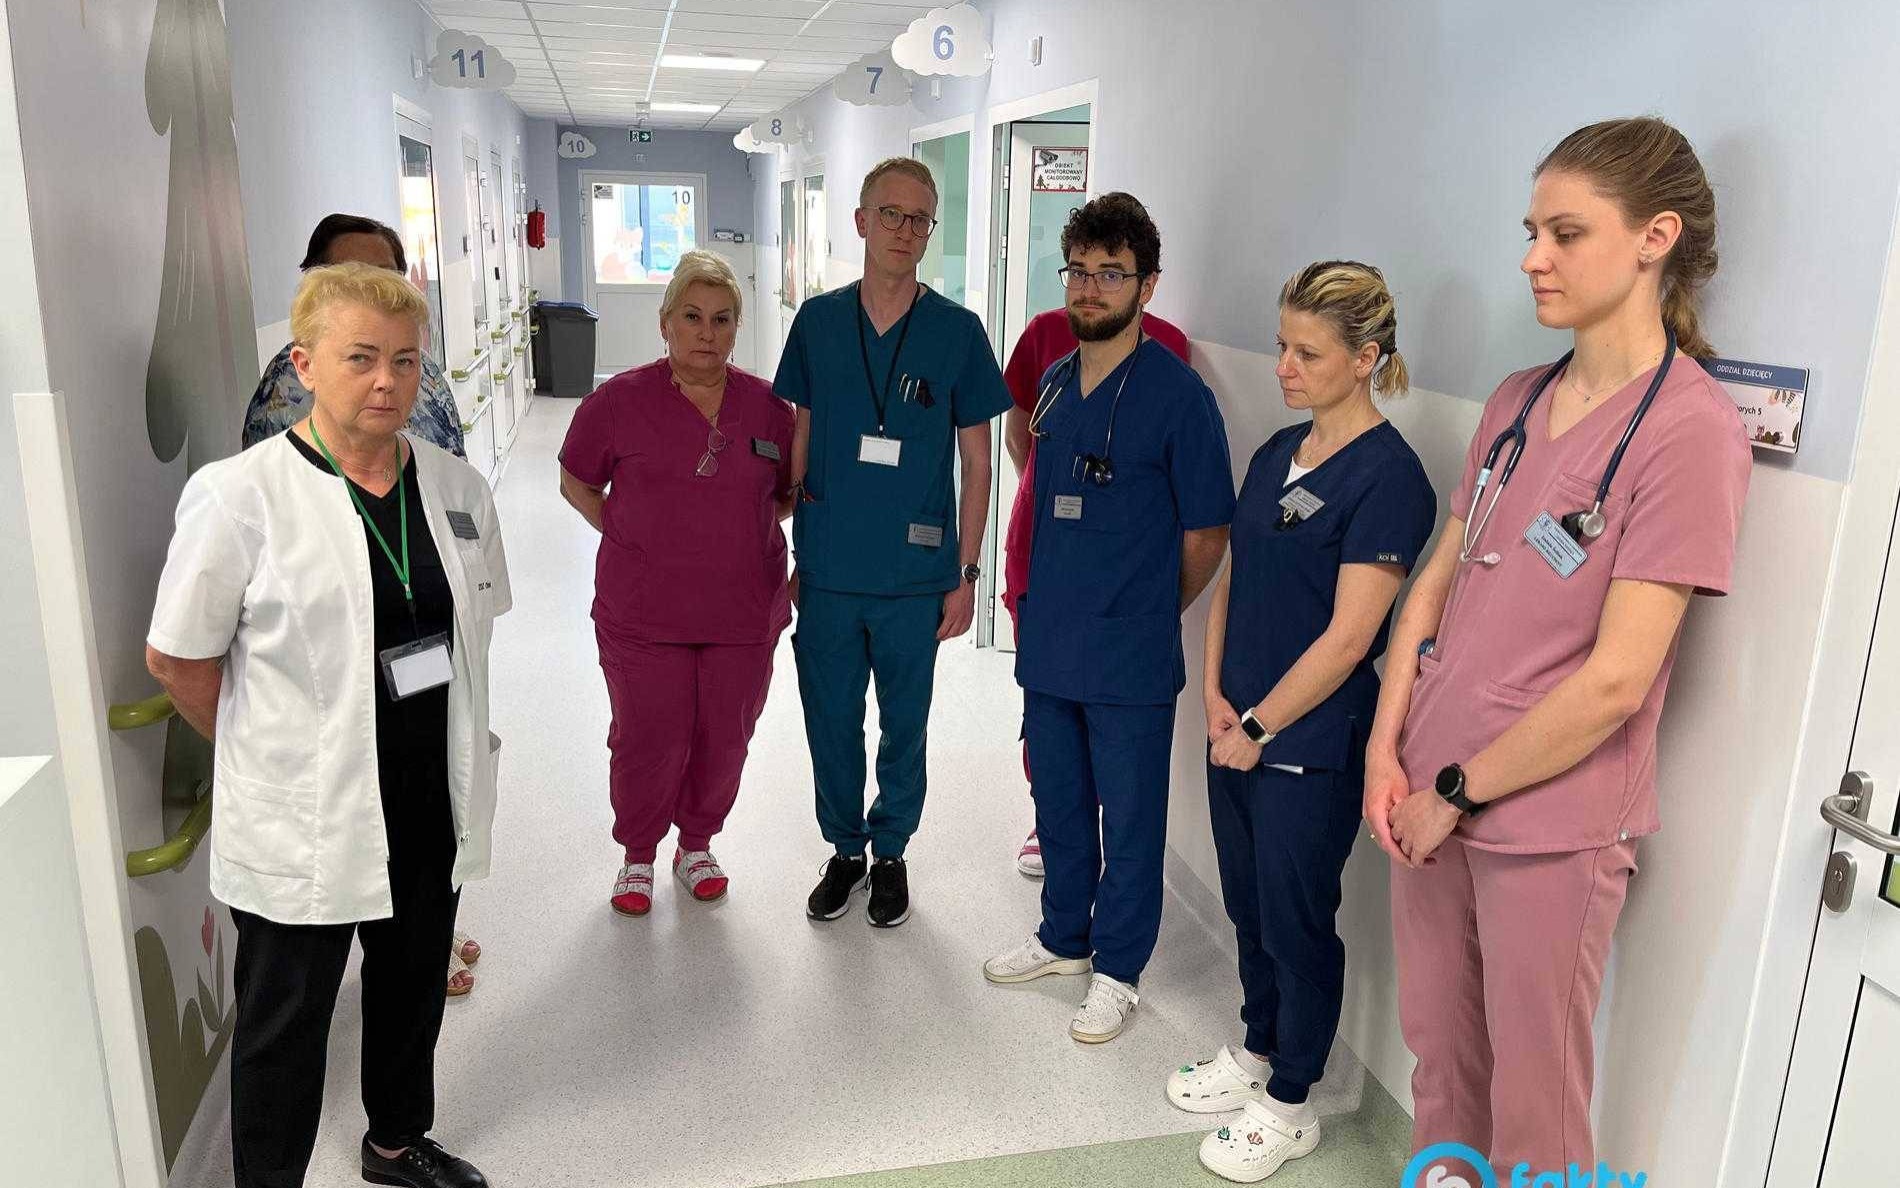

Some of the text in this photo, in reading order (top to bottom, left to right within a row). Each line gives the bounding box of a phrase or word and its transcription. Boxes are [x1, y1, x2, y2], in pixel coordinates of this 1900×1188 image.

[933, 25, 955, 60] 6
[451, 49, 485, 78] 11
[866, 67, 883, 94] 7
[771, 119, 782, 136] 8
[567, 139, 585, 153] 10
[672, 190, 691, 205] 10
[1736, 405, 1762, 416] orych 5
